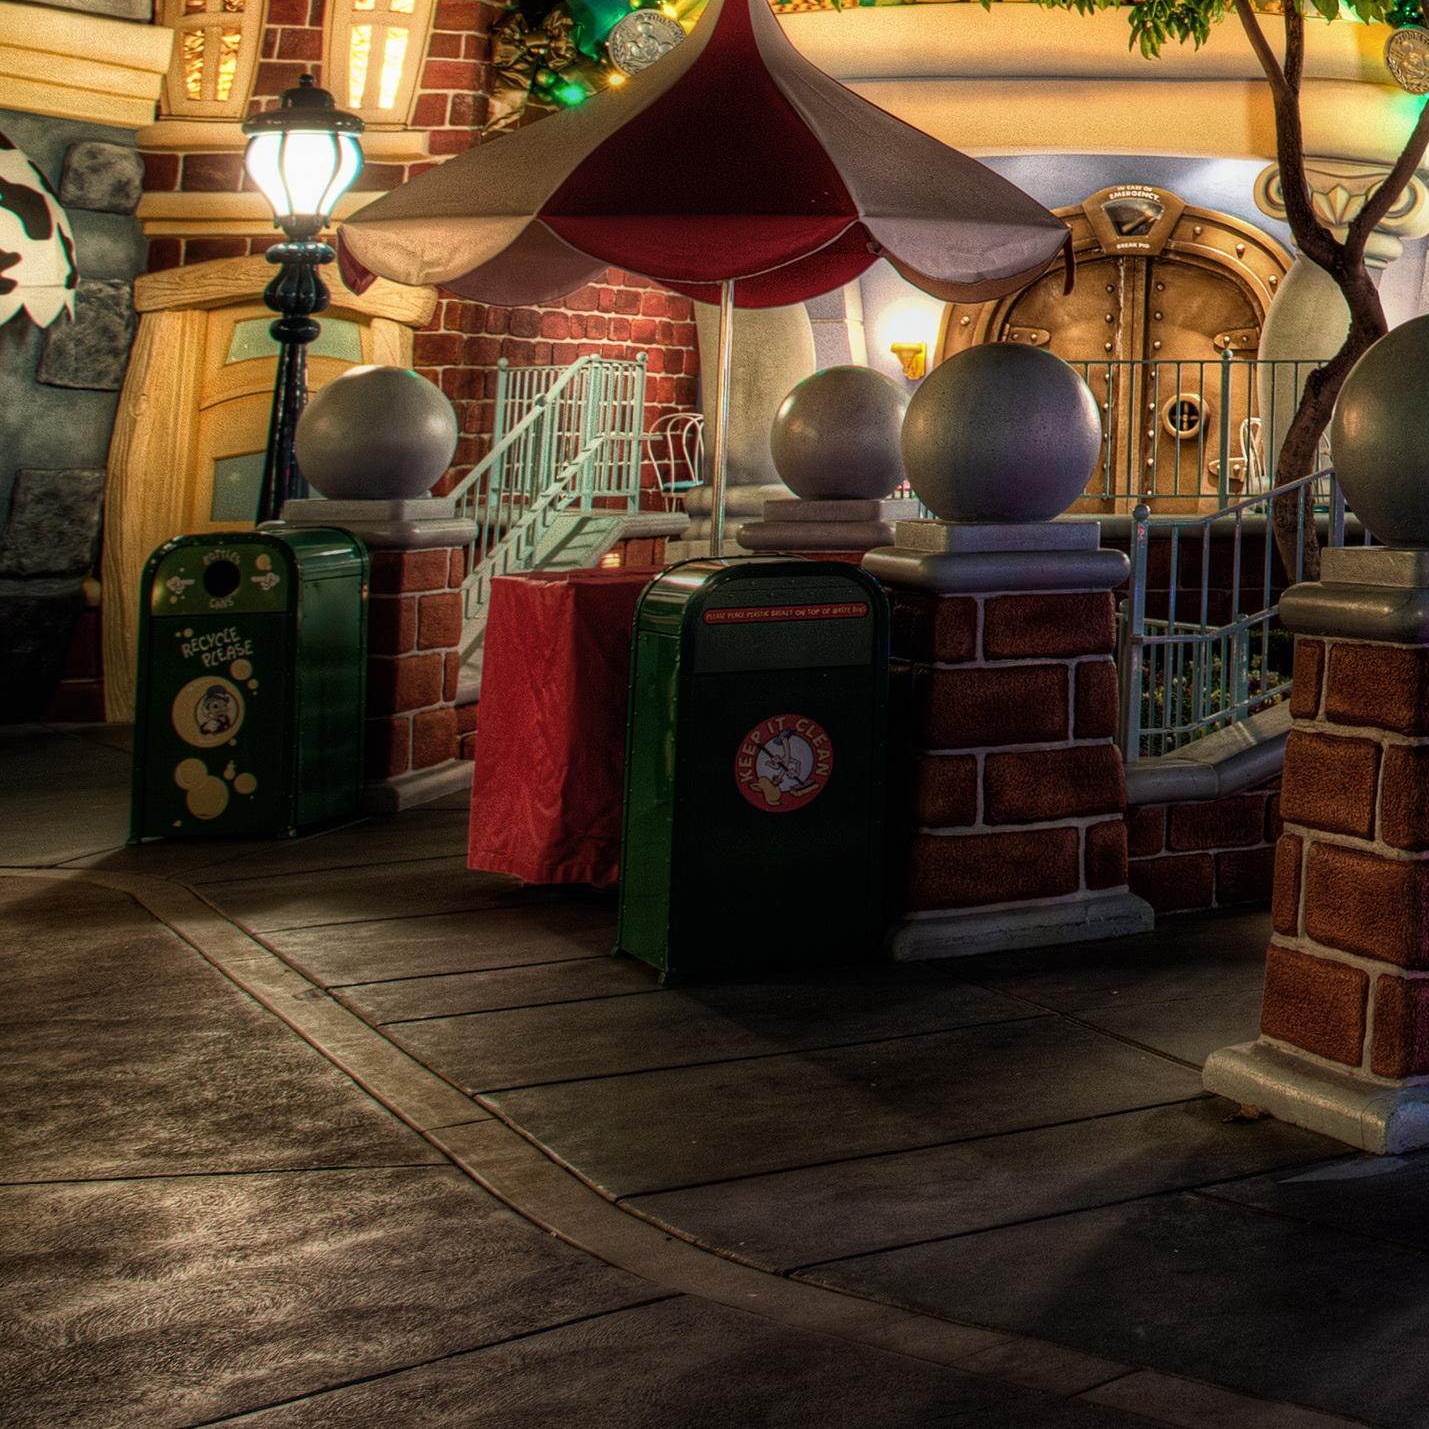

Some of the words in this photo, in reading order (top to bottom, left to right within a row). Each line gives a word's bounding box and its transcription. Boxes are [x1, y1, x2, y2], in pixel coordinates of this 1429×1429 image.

[203, 549, 240, 565] BOTTLES
[209, 598, 234, 609] CANS
[182, 627, 241, 658] RECYCLE
[202, 640, 253, 667] PLEASE
[739, 731, 761, 783] KEEP
[767, 717, 786, 734] IT
[796, 719, 830, 775] CLEAN
